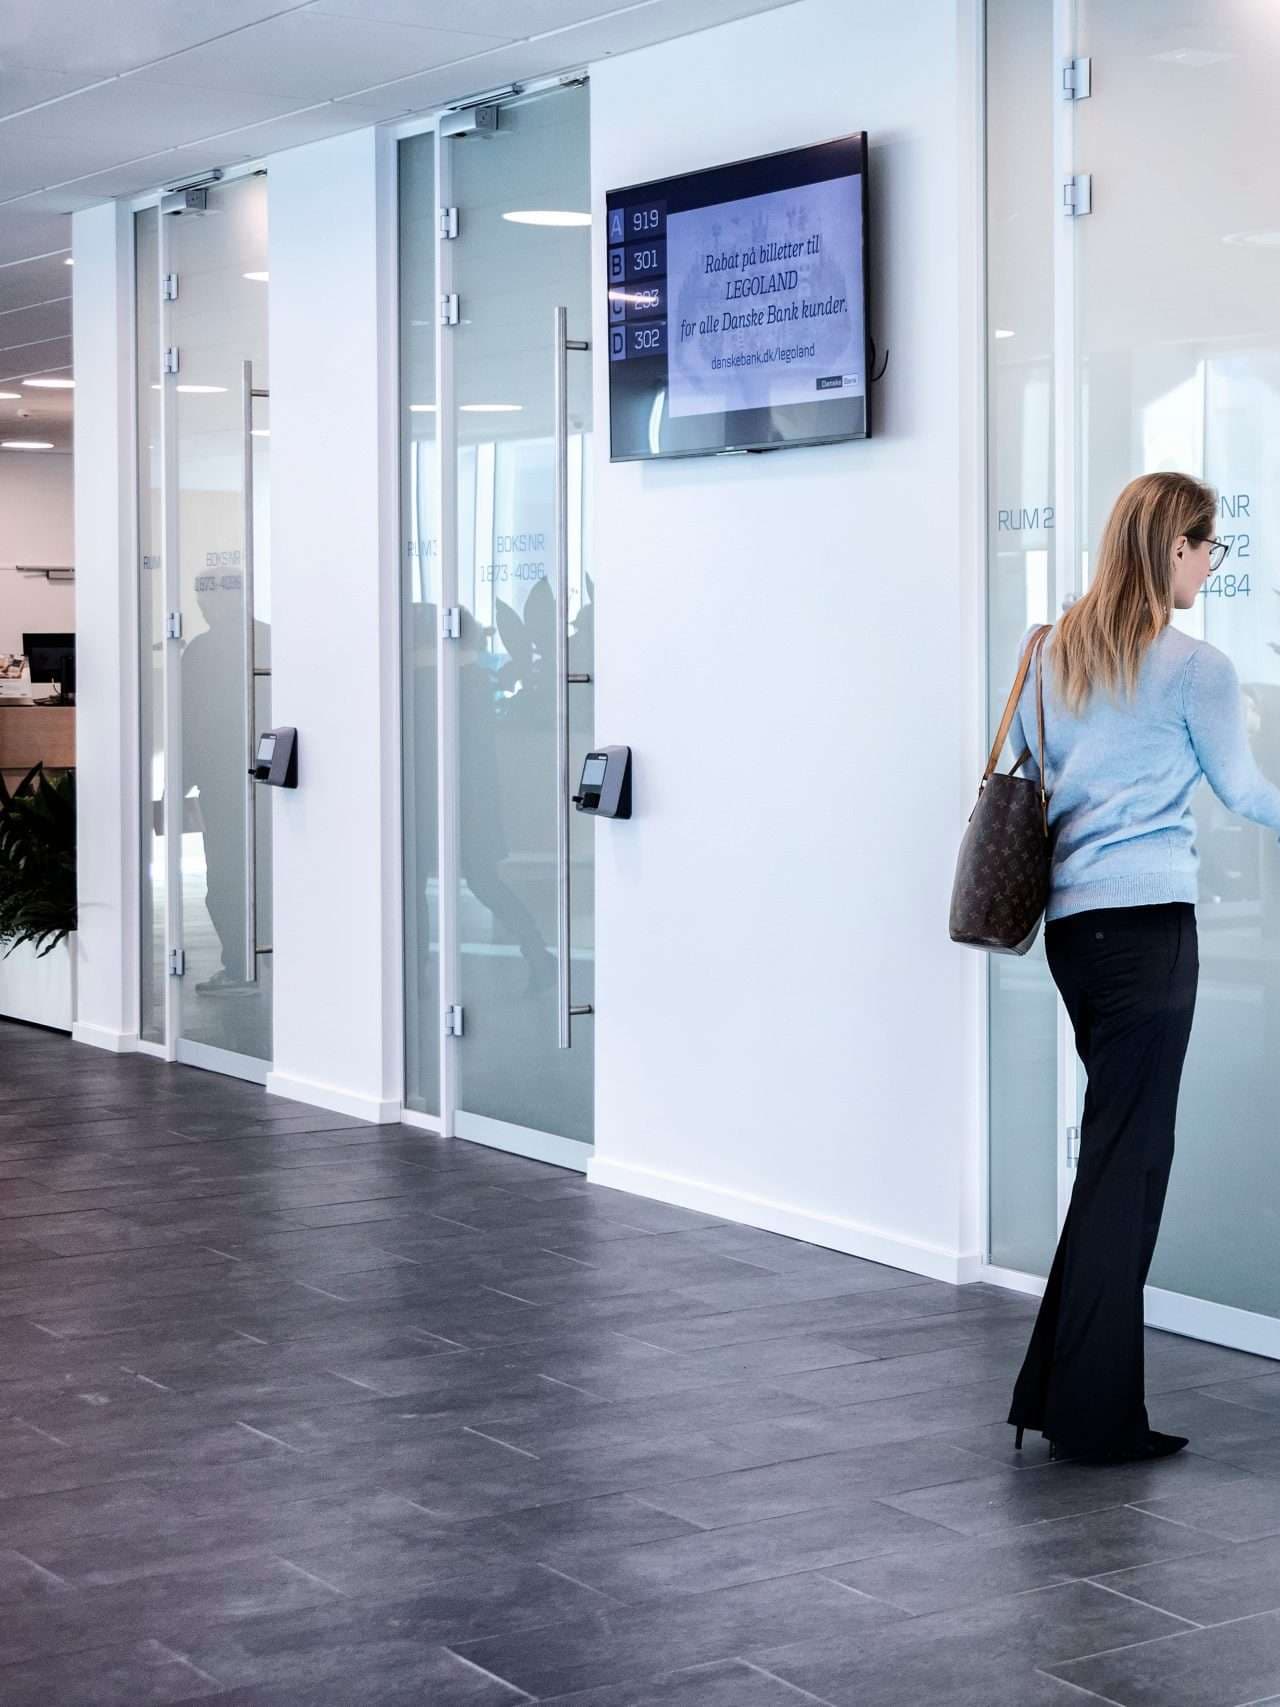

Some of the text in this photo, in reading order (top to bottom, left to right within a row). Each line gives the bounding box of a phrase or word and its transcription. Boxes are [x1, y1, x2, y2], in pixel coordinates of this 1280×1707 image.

[611, 209, 659, 238] A 919
[612, 250, 658, 276] B 301
[705, 234, 820, 274] Rabat på billetter til
[726, 270, 798, 301] LEGOLAND
[681, 319, 696, 342] for
[700, 314, 719, 334] alle
[721, 309, 764, 331] Danske
[767, 302, 798, 325] Bank
[613, 329, 660, 355] D 302
[711, 342, 815, 370] danskebank.dk/legoland
[998, 507, 1056, 532] RUM 2
[1221, 494, 1250, 519] NR
